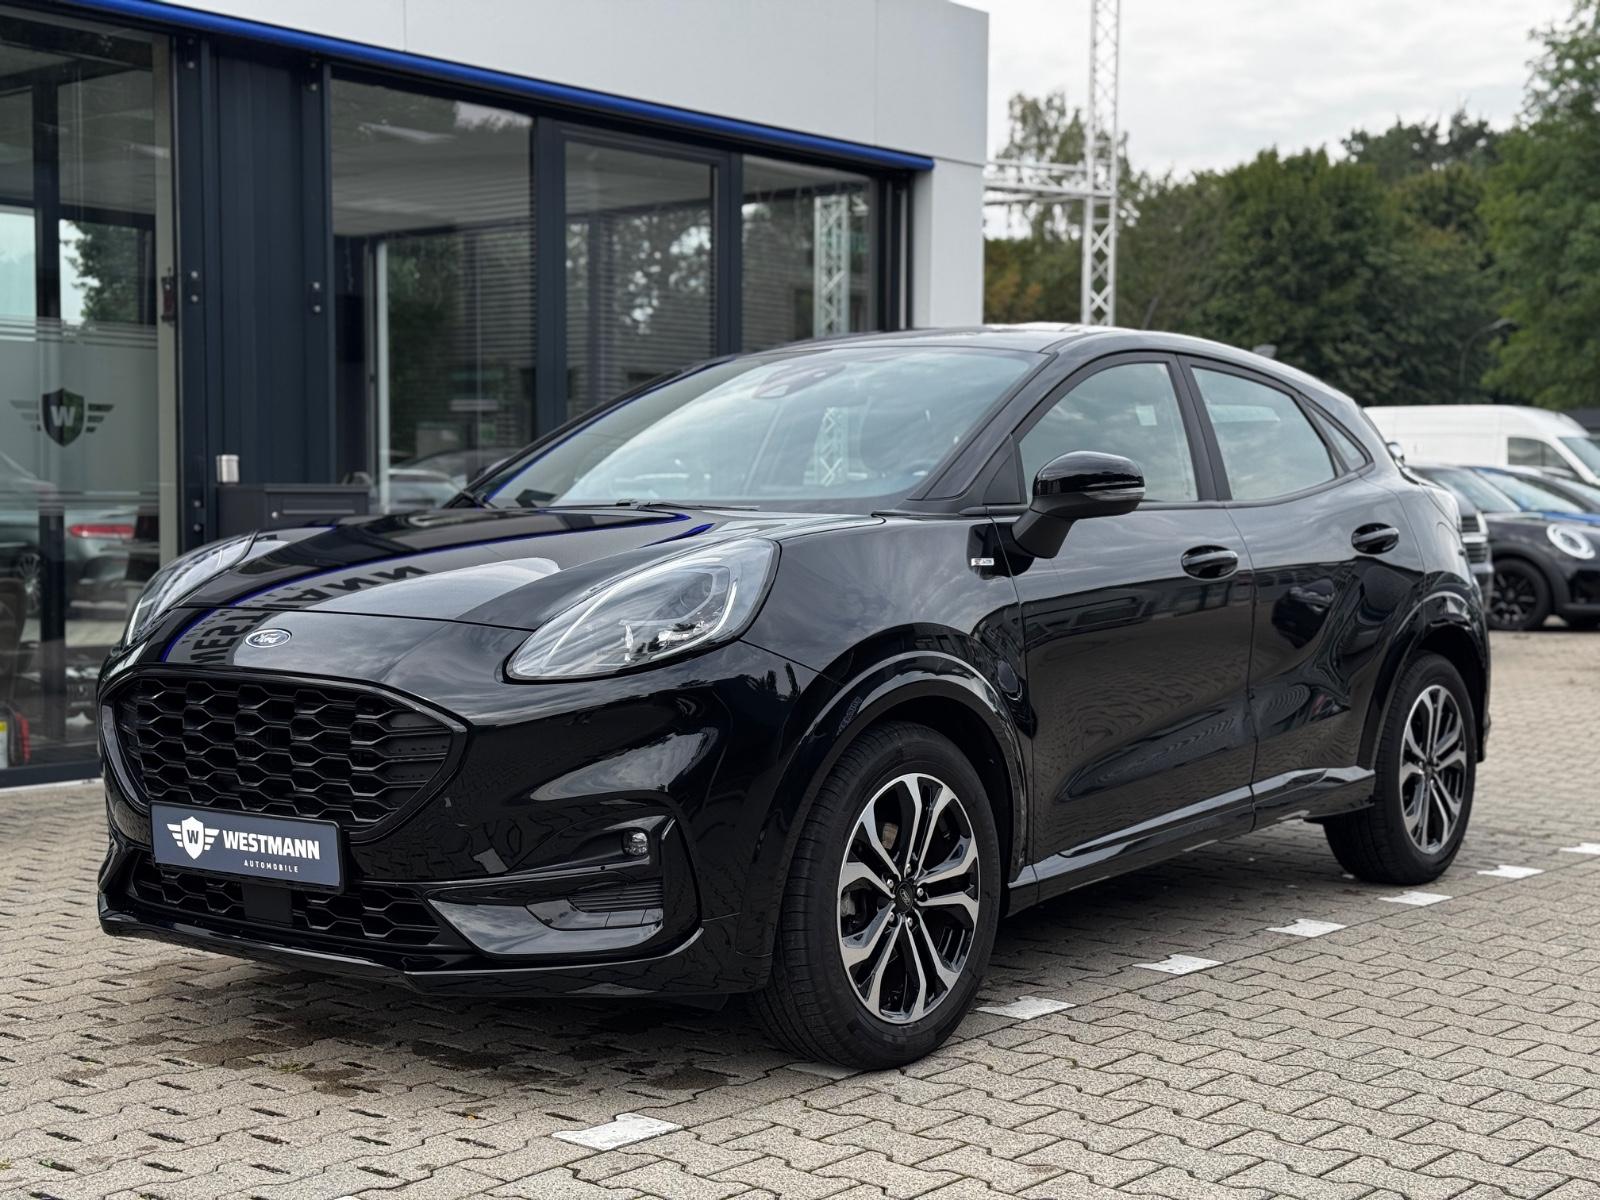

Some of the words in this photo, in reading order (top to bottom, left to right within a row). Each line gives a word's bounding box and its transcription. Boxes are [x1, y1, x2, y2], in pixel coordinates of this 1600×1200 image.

[50, 405, 76, 427] W
[186, 829, 200, 845] W
[222, 829, 321, 860] WESTMANN
[243, 859, 299, 874] AUTOMOBILE
